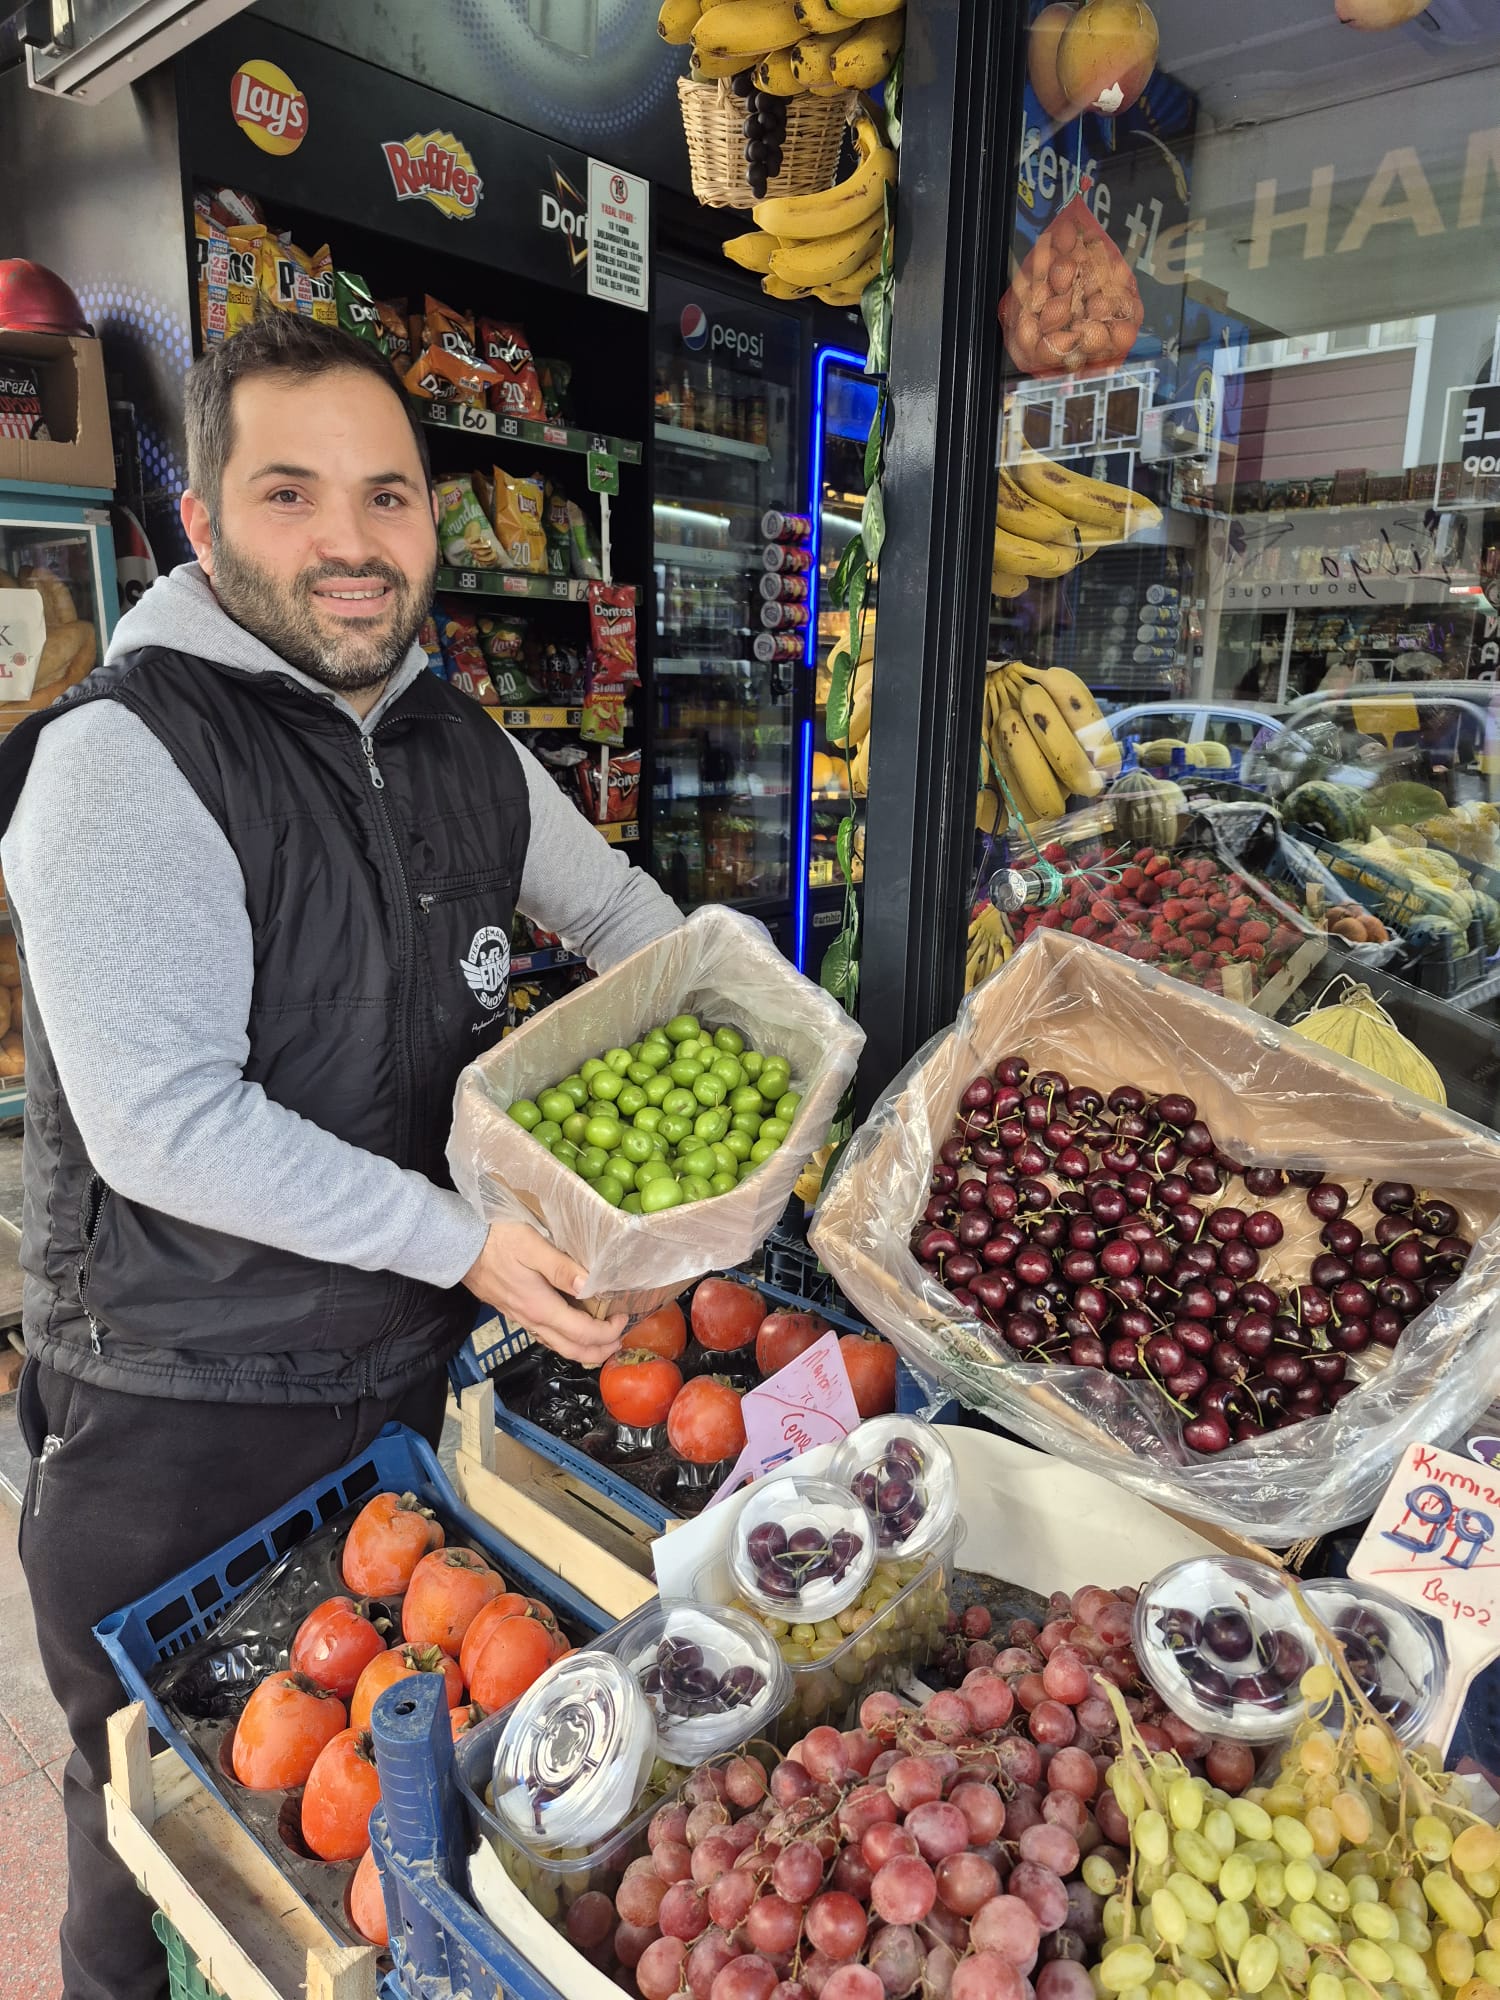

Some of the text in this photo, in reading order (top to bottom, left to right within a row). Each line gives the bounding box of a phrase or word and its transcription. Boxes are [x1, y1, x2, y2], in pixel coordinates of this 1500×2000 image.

[236, 74, 304, 136] Lay's
[382, 141, 482, 206] Ruffles
[541, 194, 588, 241] Dori
[711, 323, 764, 358] pepsi
[0, 379, 37, 395] erezza
[462, 406, 487, 429] 60
[594, 604, 634, 617] Doritos
